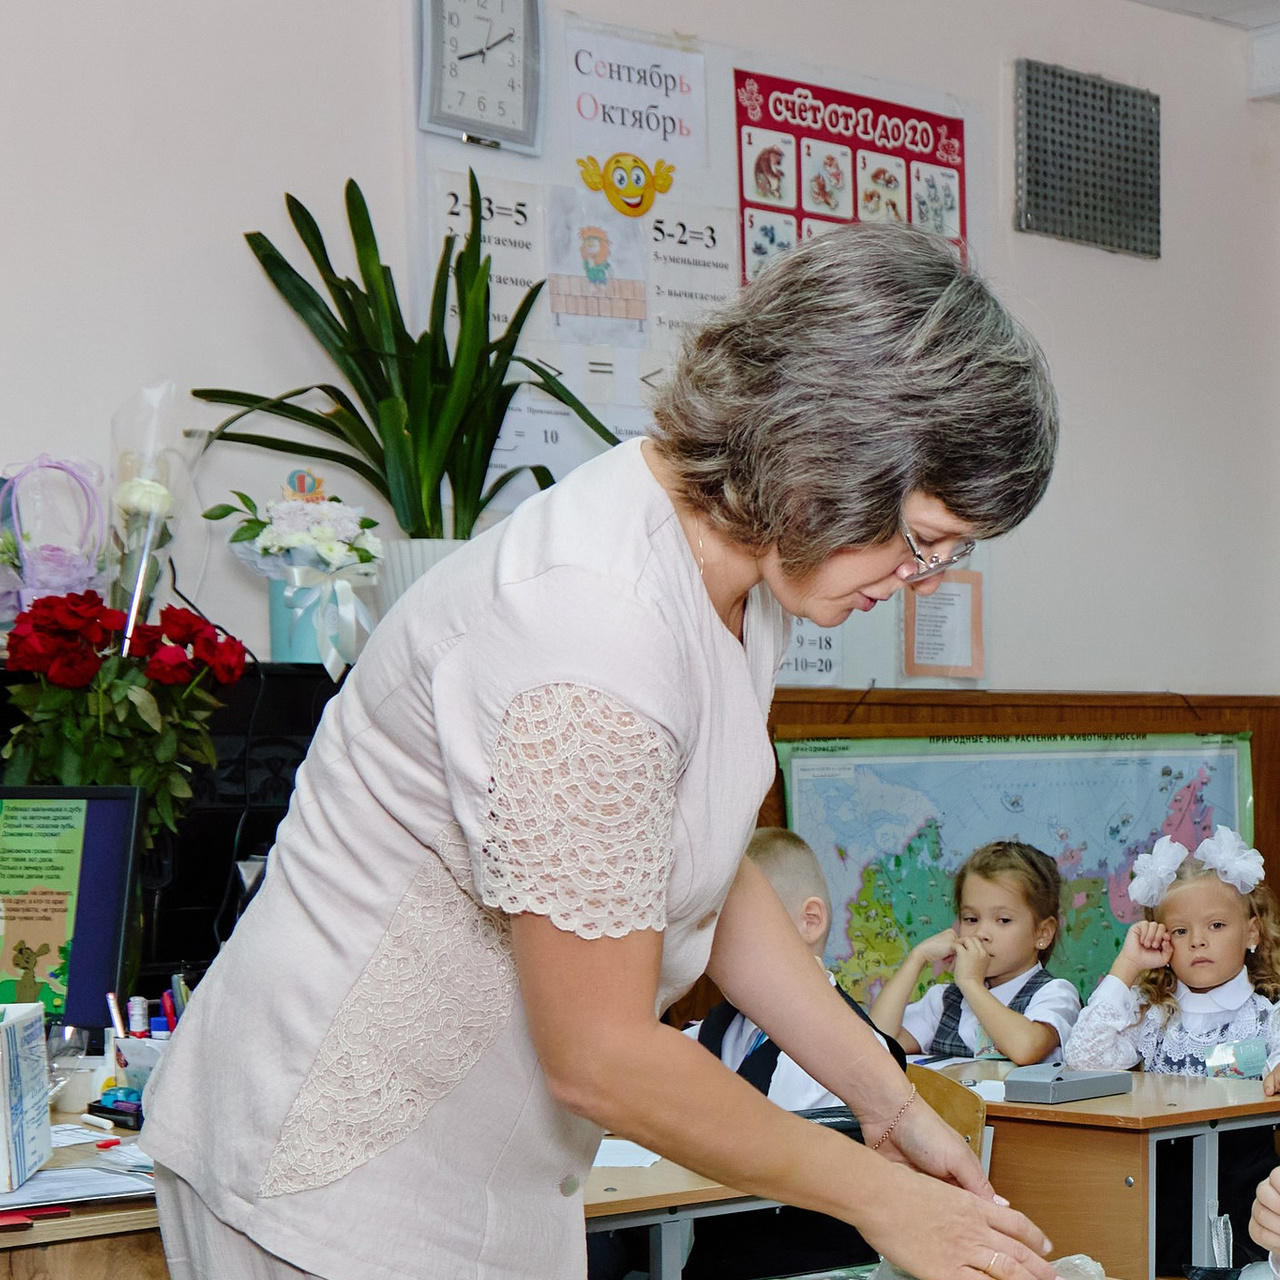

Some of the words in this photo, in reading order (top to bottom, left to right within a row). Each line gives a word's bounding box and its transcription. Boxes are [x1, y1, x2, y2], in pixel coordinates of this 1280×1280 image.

[448, 11, 459, 27] 10
[449, 36, 458, 52] 9
[508, 52, 515, 68] 3
[449, 62, 458, 78] 8
[574, 49, 692, 97] Сентябрь
[507, 78, 515, 92] 4
[457, 90, 465, 106] 7
[477, 96, 486, 112] 6
[498, 101, 505, 116] 5
[576, 92, 691, 141] Октябрь
[746, 132, 753, 145] 1
[904, 119, 934, 152] 20
[861, 156, 867, 169] 3
[915, 167, 920, 181] 4
[748, 214, 754, 228] 5
[653, 219, 716, 248] 5-2=3
[543, 429, 559, 444] 10
[929, 735, 983, 744] ПРИРОДНЫЕ
[1015, 734, 1058, 743] РАСТЕНИЯ
[1068, 733, 1112, 742] ЖИВОТНЫЕ
[1115, 733, 1147, 741] РОССИИ
